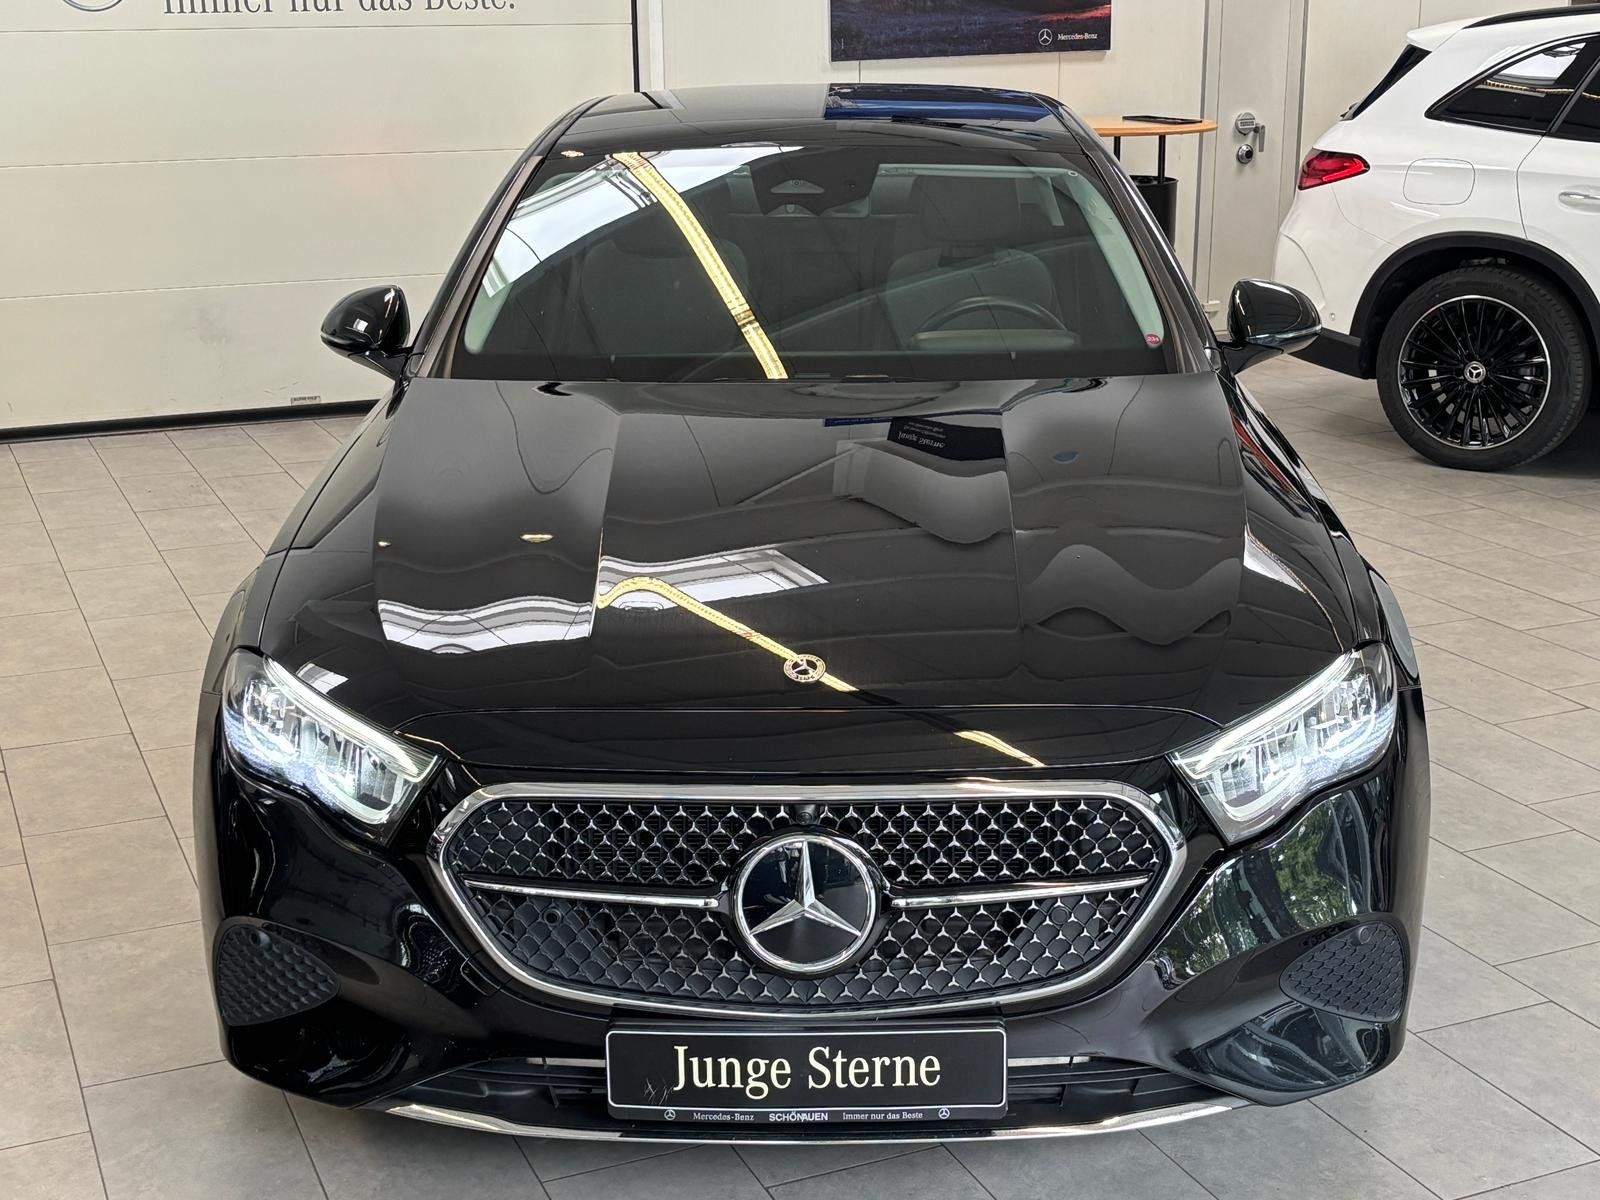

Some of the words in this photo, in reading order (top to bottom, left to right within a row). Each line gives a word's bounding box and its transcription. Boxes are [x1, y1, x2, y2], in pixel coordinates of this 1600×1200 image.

[1057, 33, 1098, 41] Mercedes-Benz
[673, 1045, 791, 1100] Junge
[808, 1046, 940, 1089] Sterne
[693, 1112, 754, 1121] Mercedes-Benz
[769, 1110, 828, 1122] SCHÖNAUEN
[842, 1112, 868, 1120] Immer
[886, 1111, 900, 1119] das
[902, 1111, 923, 1119] Beste
